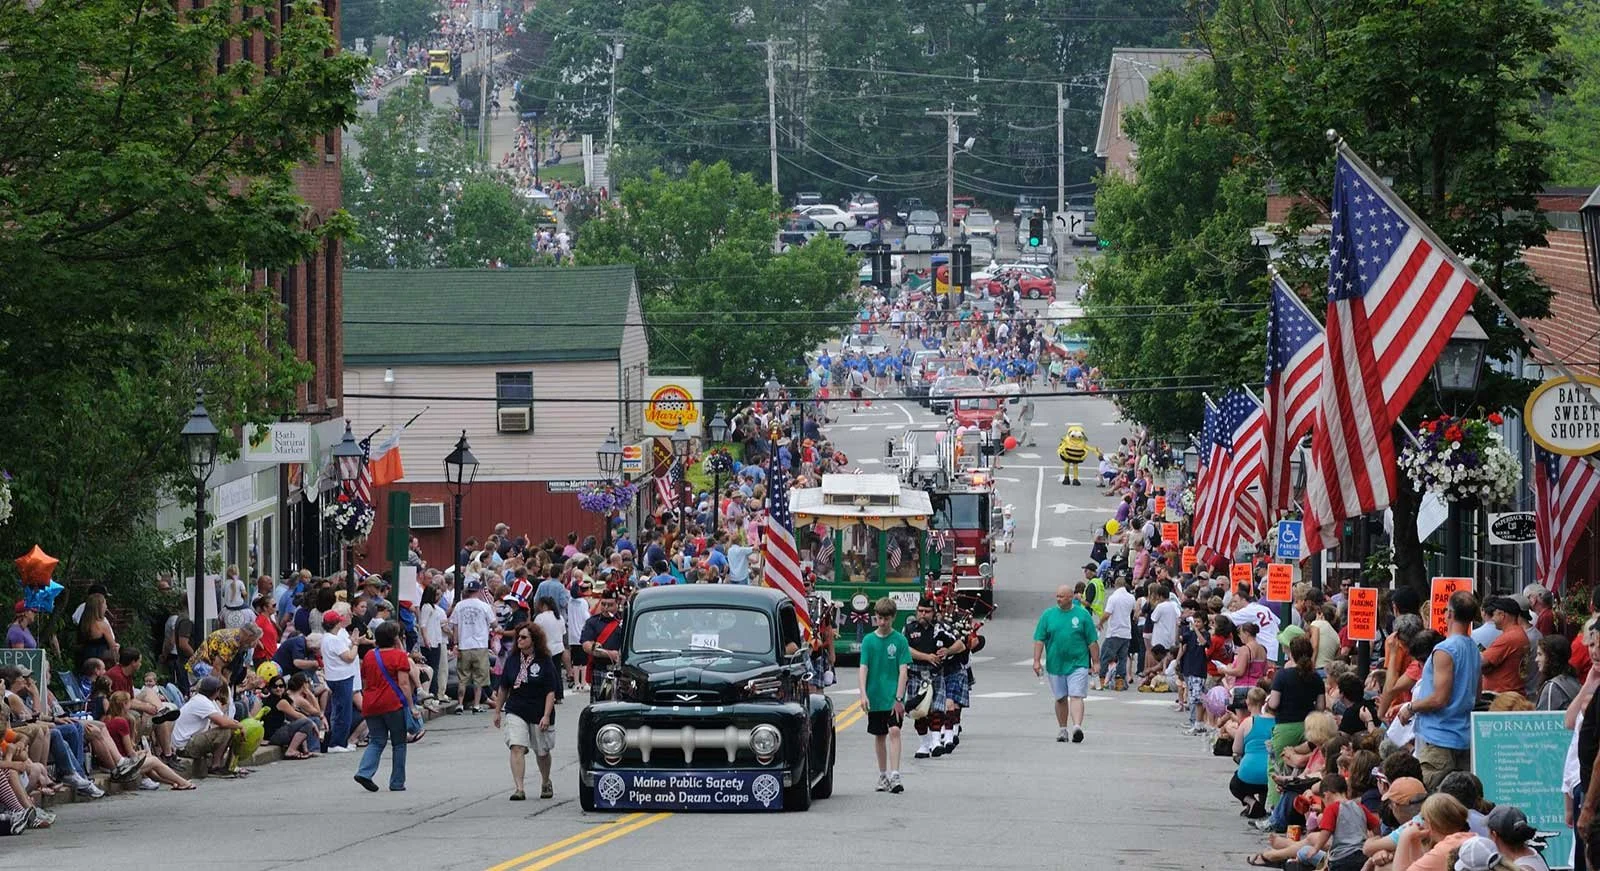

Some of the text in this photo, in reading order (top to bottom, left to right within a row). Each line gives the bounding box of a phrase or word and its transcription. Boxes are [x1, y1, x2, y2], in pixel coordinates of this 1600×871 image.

[1554, 404, 1597, 421] SWEET
[275, 431, 296, 439] Bath
[1551, 422, 1600, 438] SHOPPE
[275, 438, 306, 447] Natural
[275, 446, 304, 454] Market
[1494, 515, 1523, 529] PAPERBACK
[1446, 583, 1456, 592] NO
[0, 651, 37, 671] PPY
[1493, 720, 1565, 731] ORNAMEN
[633, 776, 667, 787] Maine
[670, 776, 702, 788] Public
[706, 777, 744, 791] Safety
[629, 791, 749, 806] Pipe and Drum Corps
